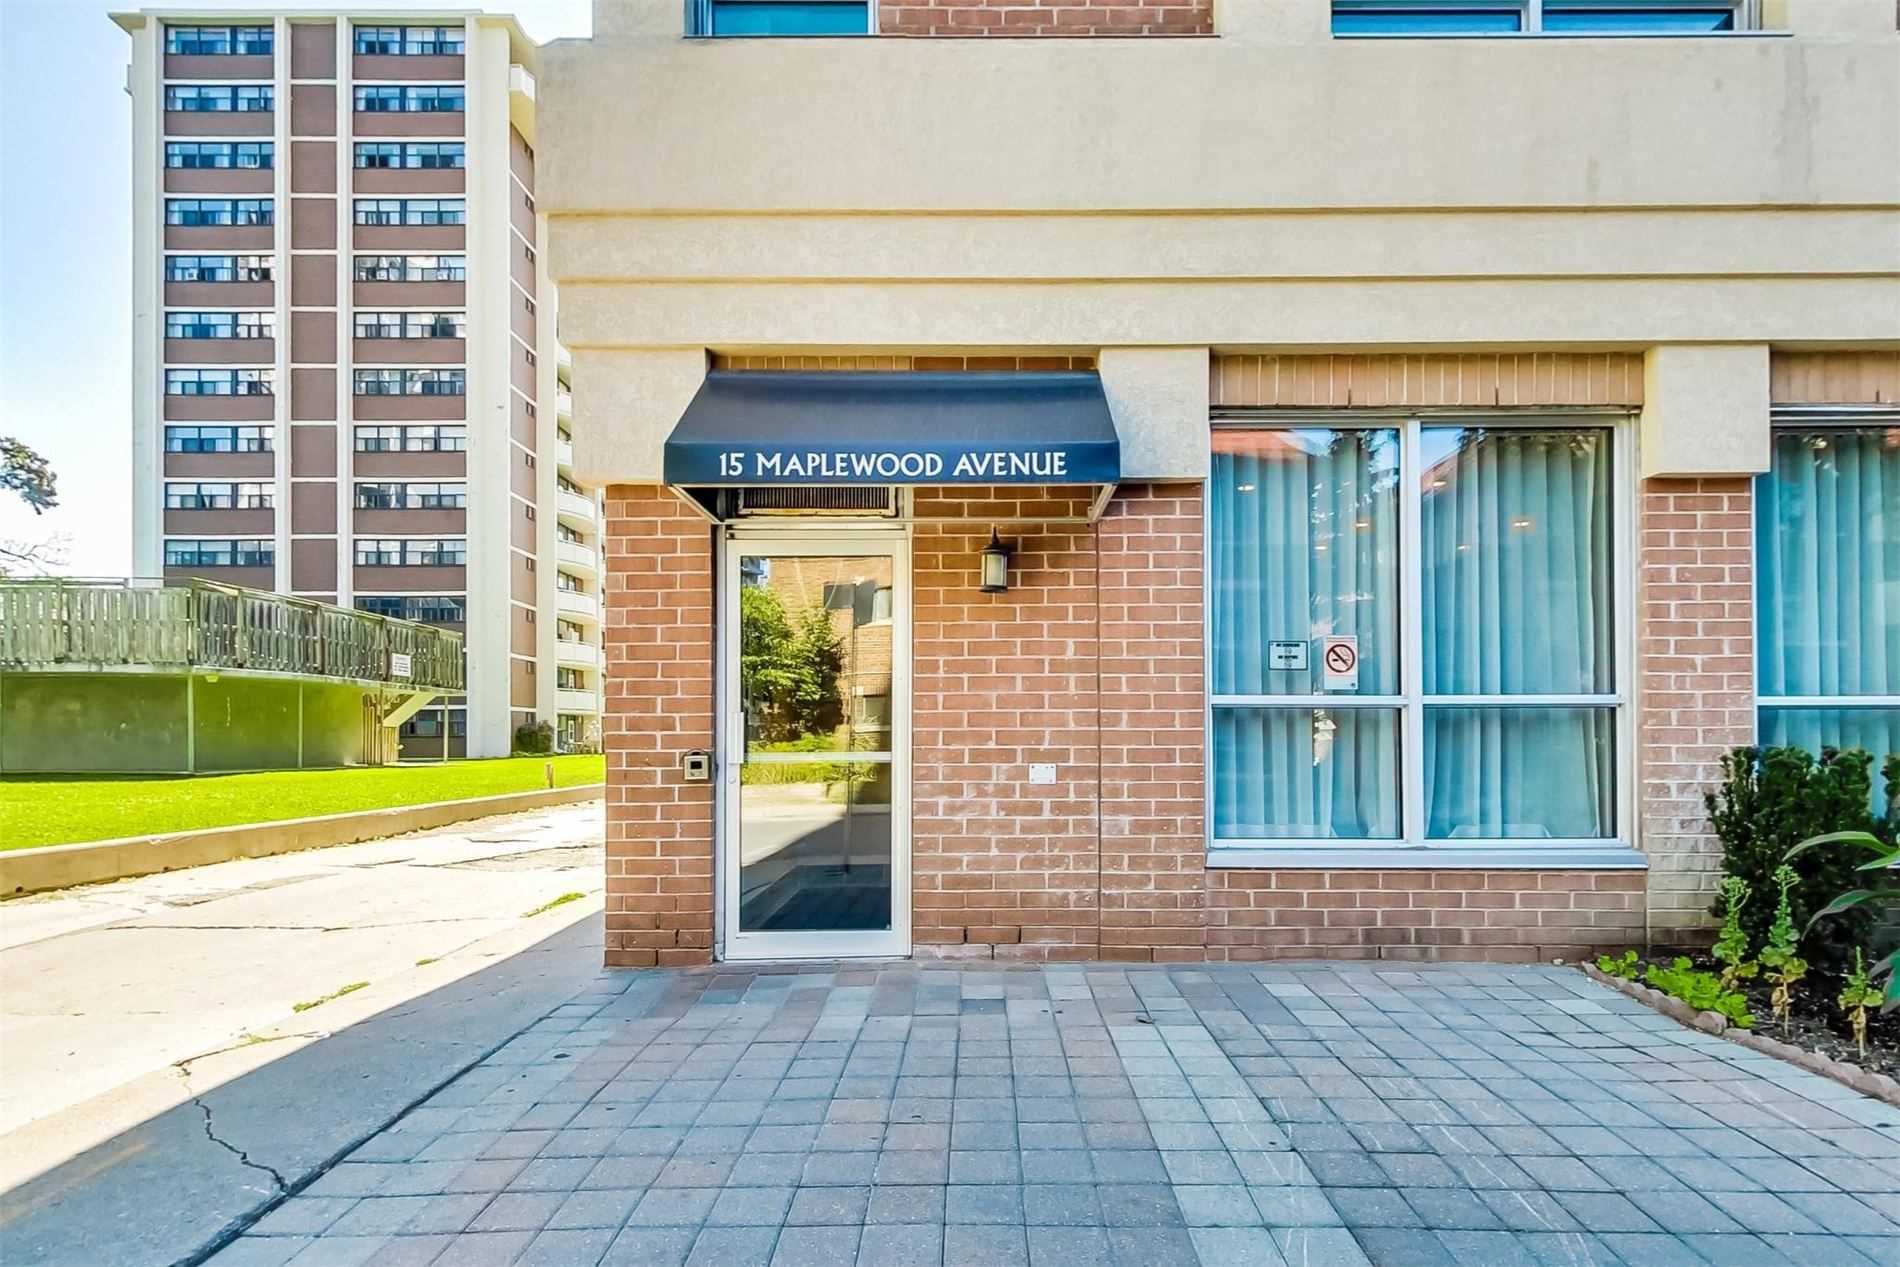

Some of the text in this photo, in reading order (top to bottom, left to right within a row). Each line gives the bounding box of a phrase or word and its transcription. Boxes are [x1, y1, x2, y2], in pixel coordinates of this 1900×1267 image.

[719, 451, 1068, 477] 15 MAPLEWOOD AVENUE
